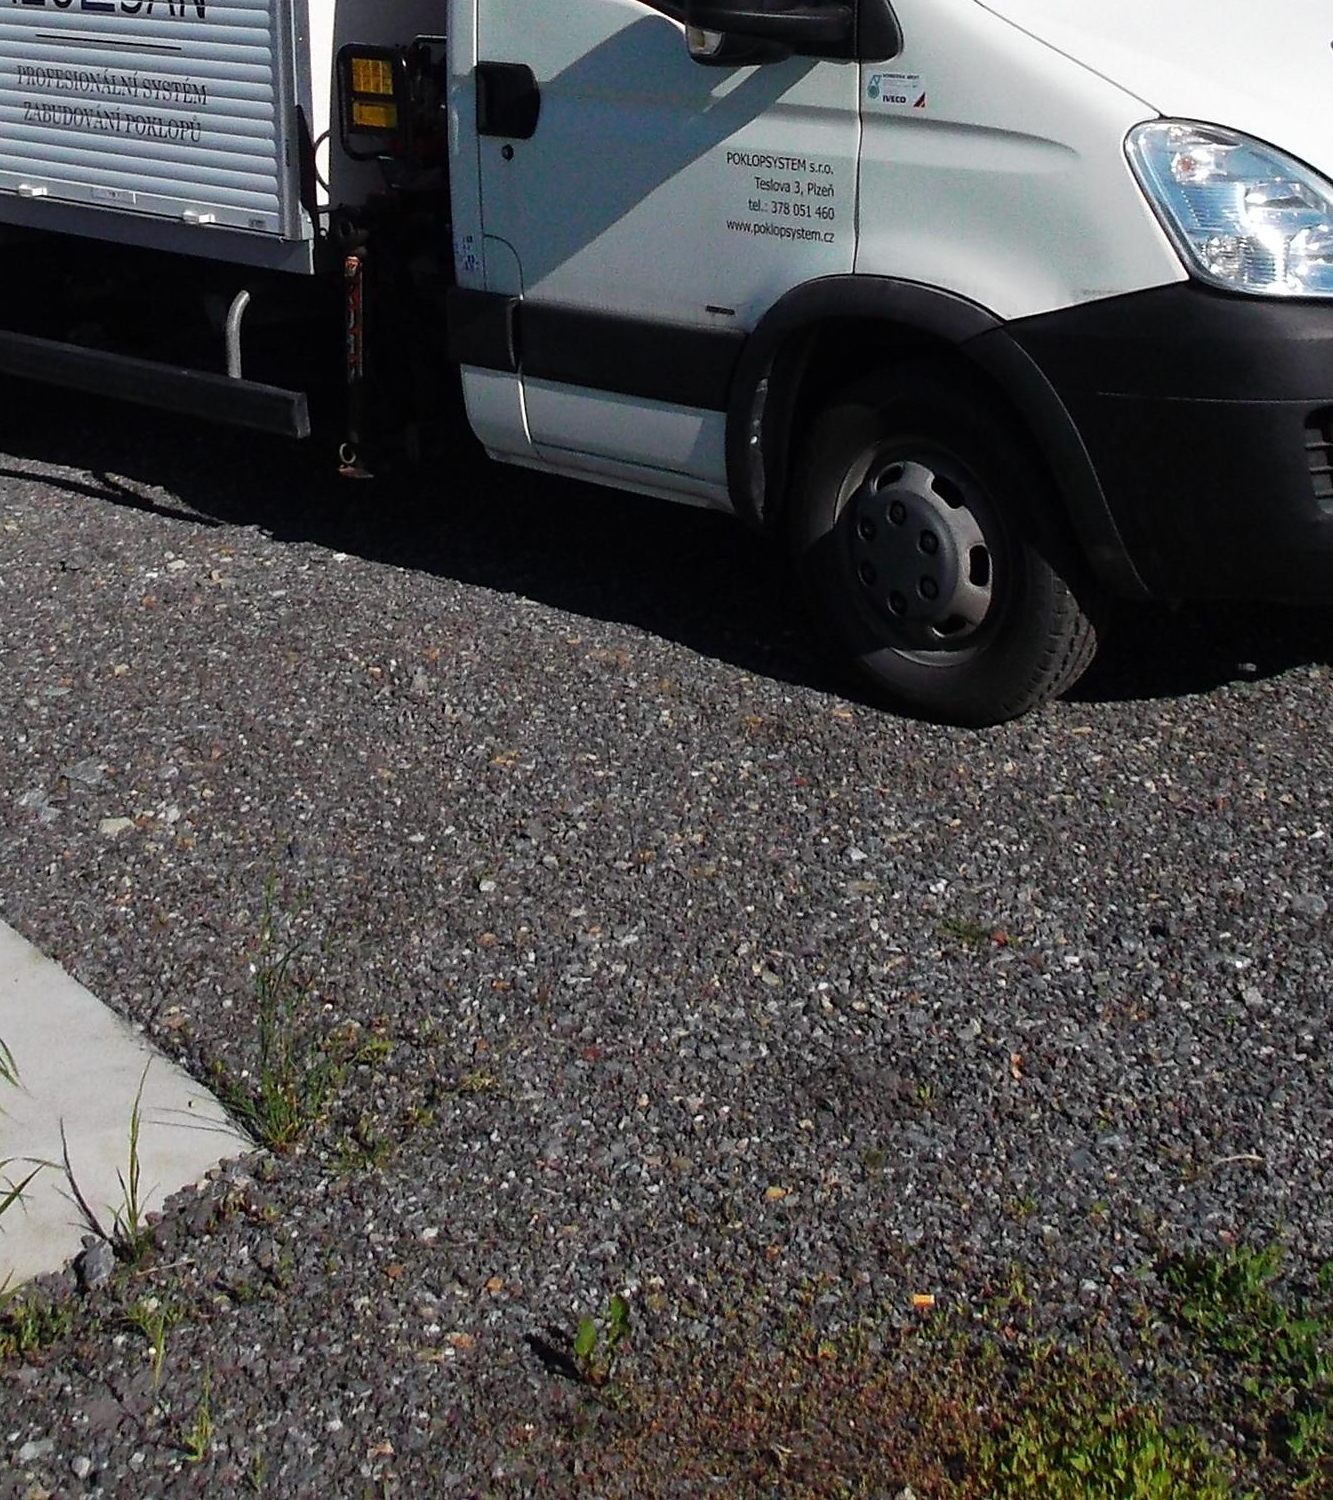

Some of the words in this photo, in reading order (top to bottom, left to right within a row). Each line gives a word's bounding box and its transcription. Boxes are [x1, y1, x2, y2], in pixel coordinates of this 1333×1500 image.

[17, 65, 139, 98] PROFESIONÁLNÍ
[142, 77, 208, 105] SYSTÉM
[23, 101, 121, 132] ZABUDOVÁNÍ
[125, 113, 201, 142] POKLOPŮ
[727, 152, 806, 172] POKLOPSYSTEM
[809, 162, 834, 175] s.r.o.
[754, 177, 790, 193] Teslova
[794, 181, 804, 196] 3,
[807, 182, 834, 197] Plzeň
[748, 199, 768, 213] tel.:
[771, 200, 790, 215] 378
[793, 203, 811, 218] 051
[815, 206, 835, 220] 460
[726, 220, 835, 243] www.poklopsystem.cz
